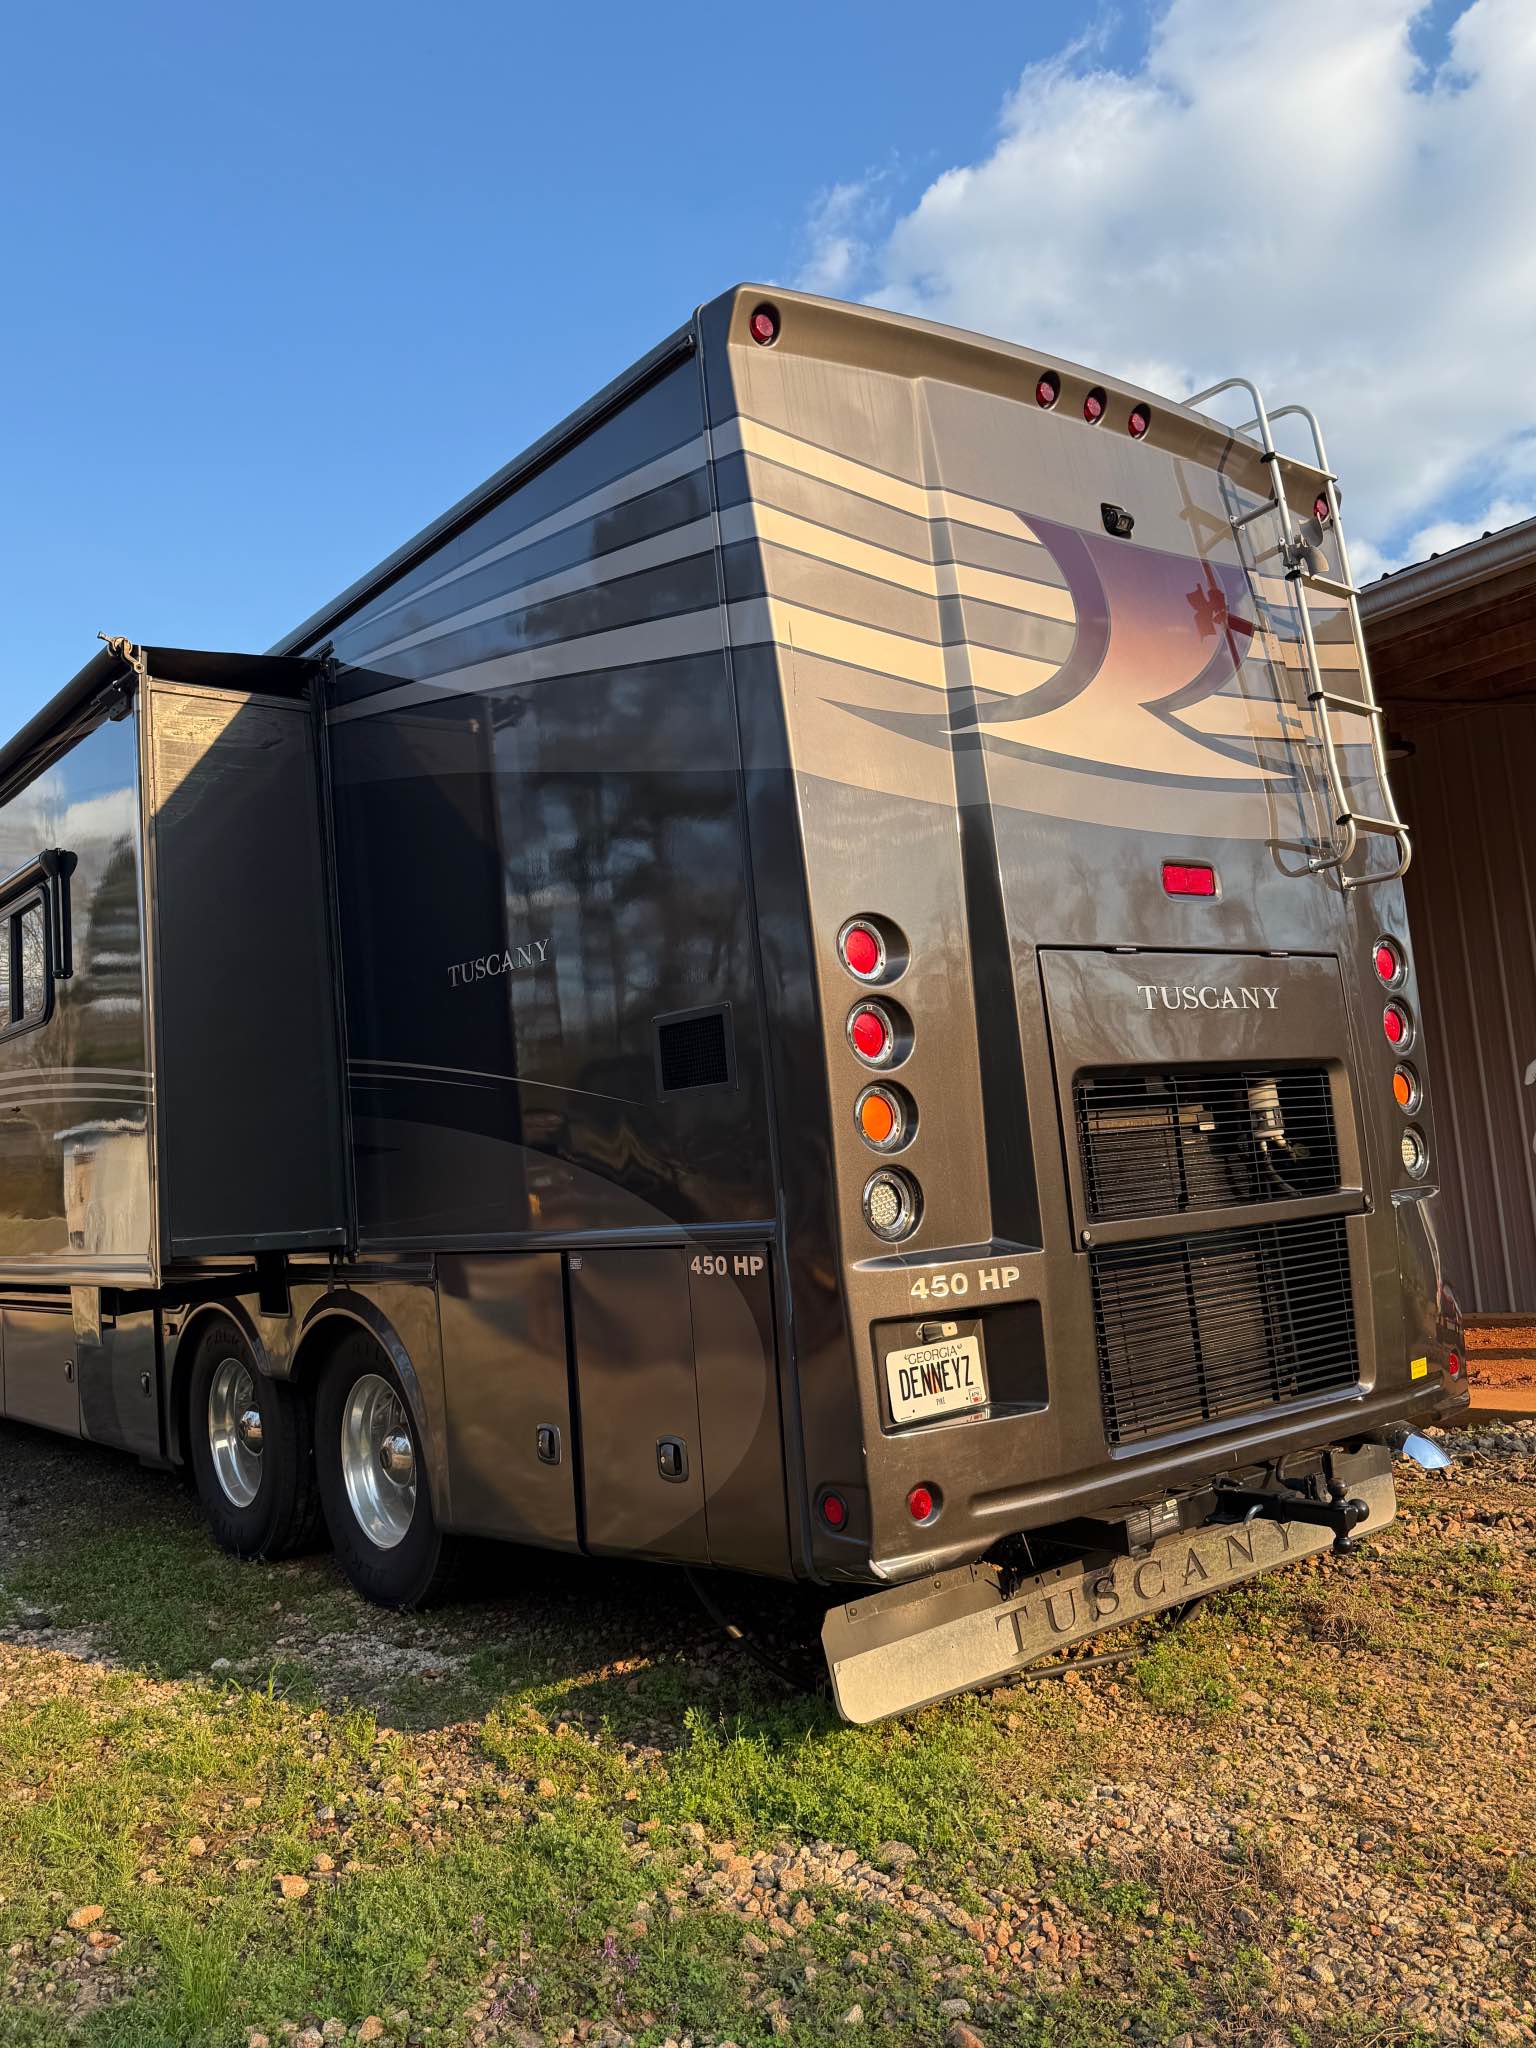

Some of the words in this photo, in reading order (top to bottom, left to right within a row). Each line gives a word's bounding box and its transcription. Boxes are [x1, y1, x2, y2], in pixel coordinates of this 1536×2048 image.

[447, 938, 550, 988] TUSCANY
[1136, 985, 1280, 1010] TUSCANY
[690, 1255, 728, 1276] 450
[733, 1255, 764, 1276] HP
[910, 1272, 969, 1299] 450
[977, 1266, 1020, 1291] HP
[908, 1345, 958, 1365] GEORGIA
[898, 1355, 974, 1401] DENNEYZ
[994, 1520, 1292, 1657] TUSCANY
